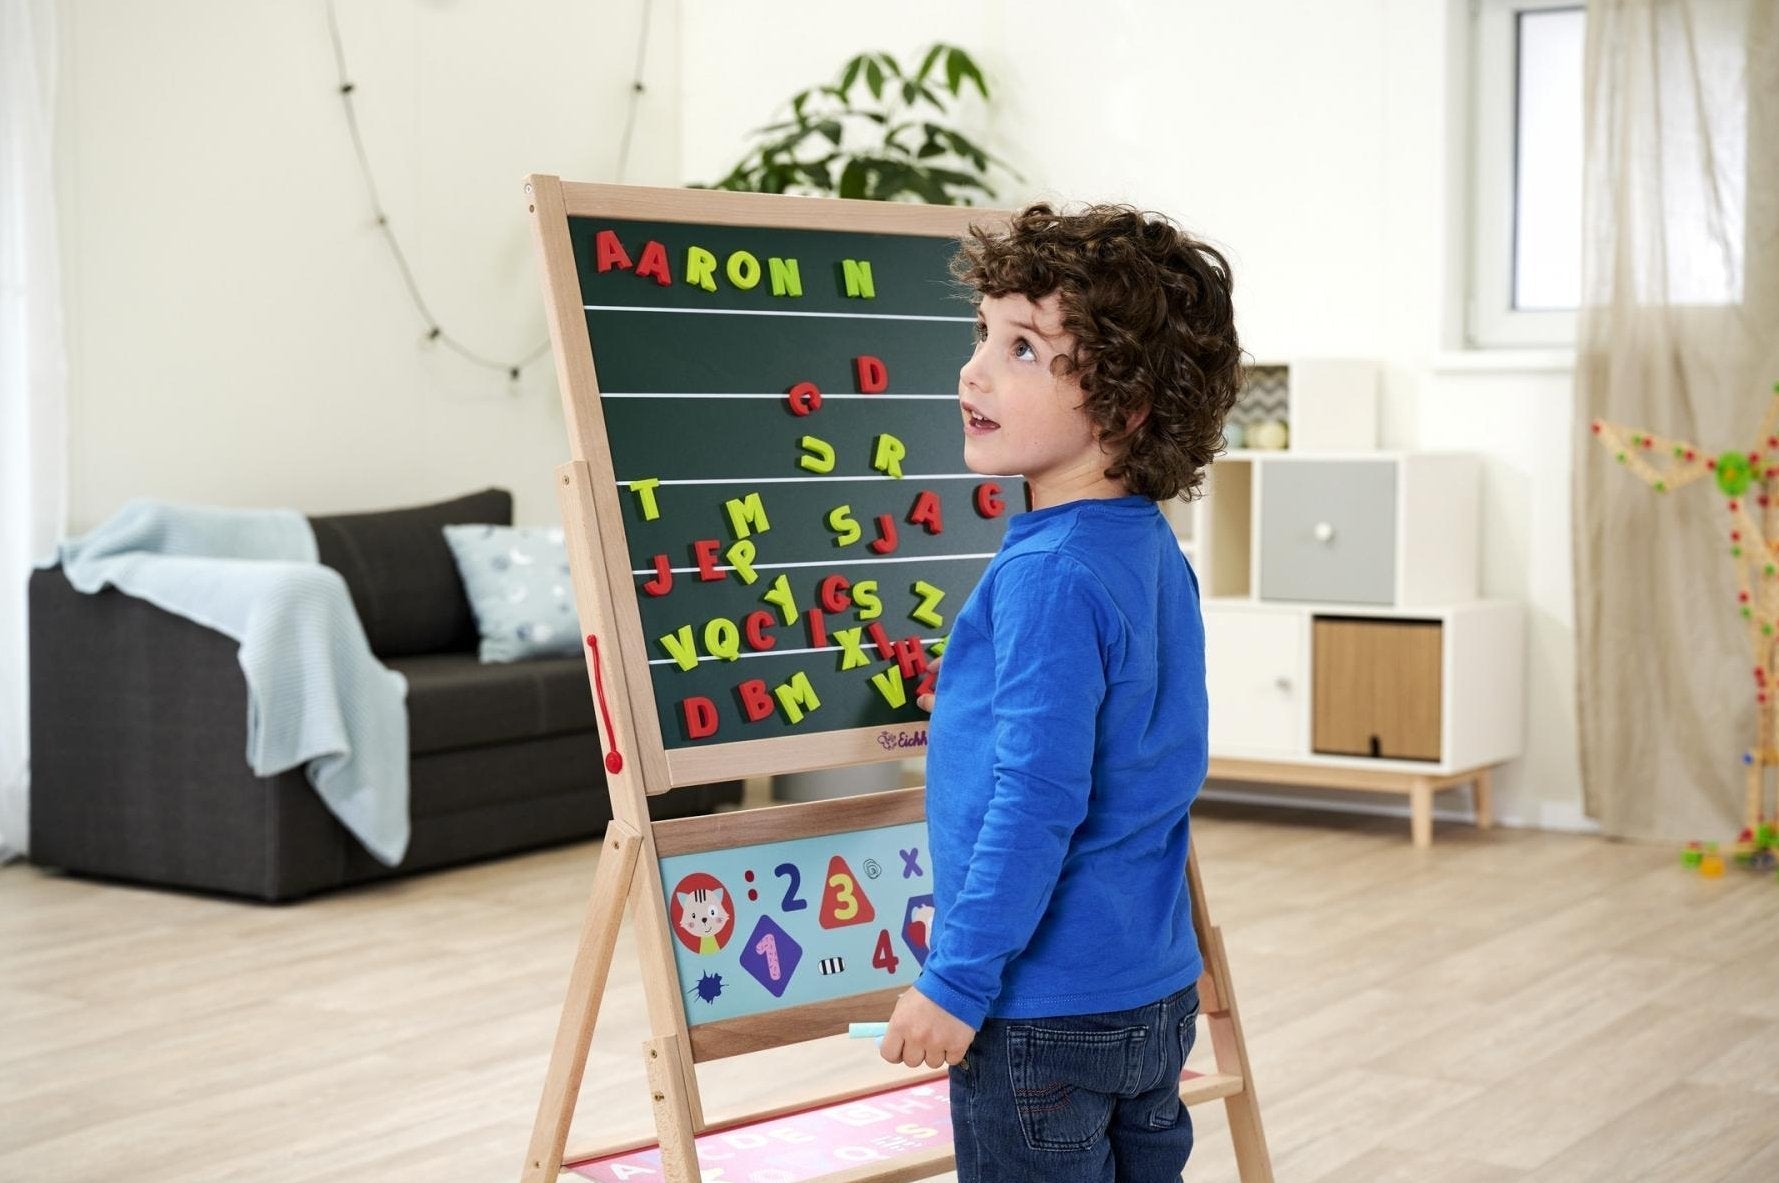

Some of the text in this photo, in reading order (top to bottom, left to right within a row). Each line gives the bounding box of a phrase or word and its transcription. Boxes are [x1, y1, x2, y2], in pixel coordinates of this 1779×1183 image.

[595, 229, 876, 299] AARON N
[856, 355, 888, 395] D
[875, 432, 907, 479] R
[629, 477, 660, 521] T
[725, 491, 771, 540] M
[910, 490, 943, 535] A
[829, 504, 862, 547] S
[872, 513, 898, 554] J
[643, 554, 673, 596] J
[694, 539, 728, 582] E
[726, 539, 759, 585] P
[764, 574, 799, 626] Y
[852, 580, 883, 620] S
[912, 580, 945, 629] Z
[832, 626, 870, 671] X
[738, 679, 775, 722] B
[775, 671, 821, 724] M
[872, 664, 907, 709] V
[683, 696, 719, 739] D
[774, 863, 807, 912] 2
[829, 873, 859, 920] 3
[756, 934, 781, 981] 1
[872, 929, 899, 974] 4
